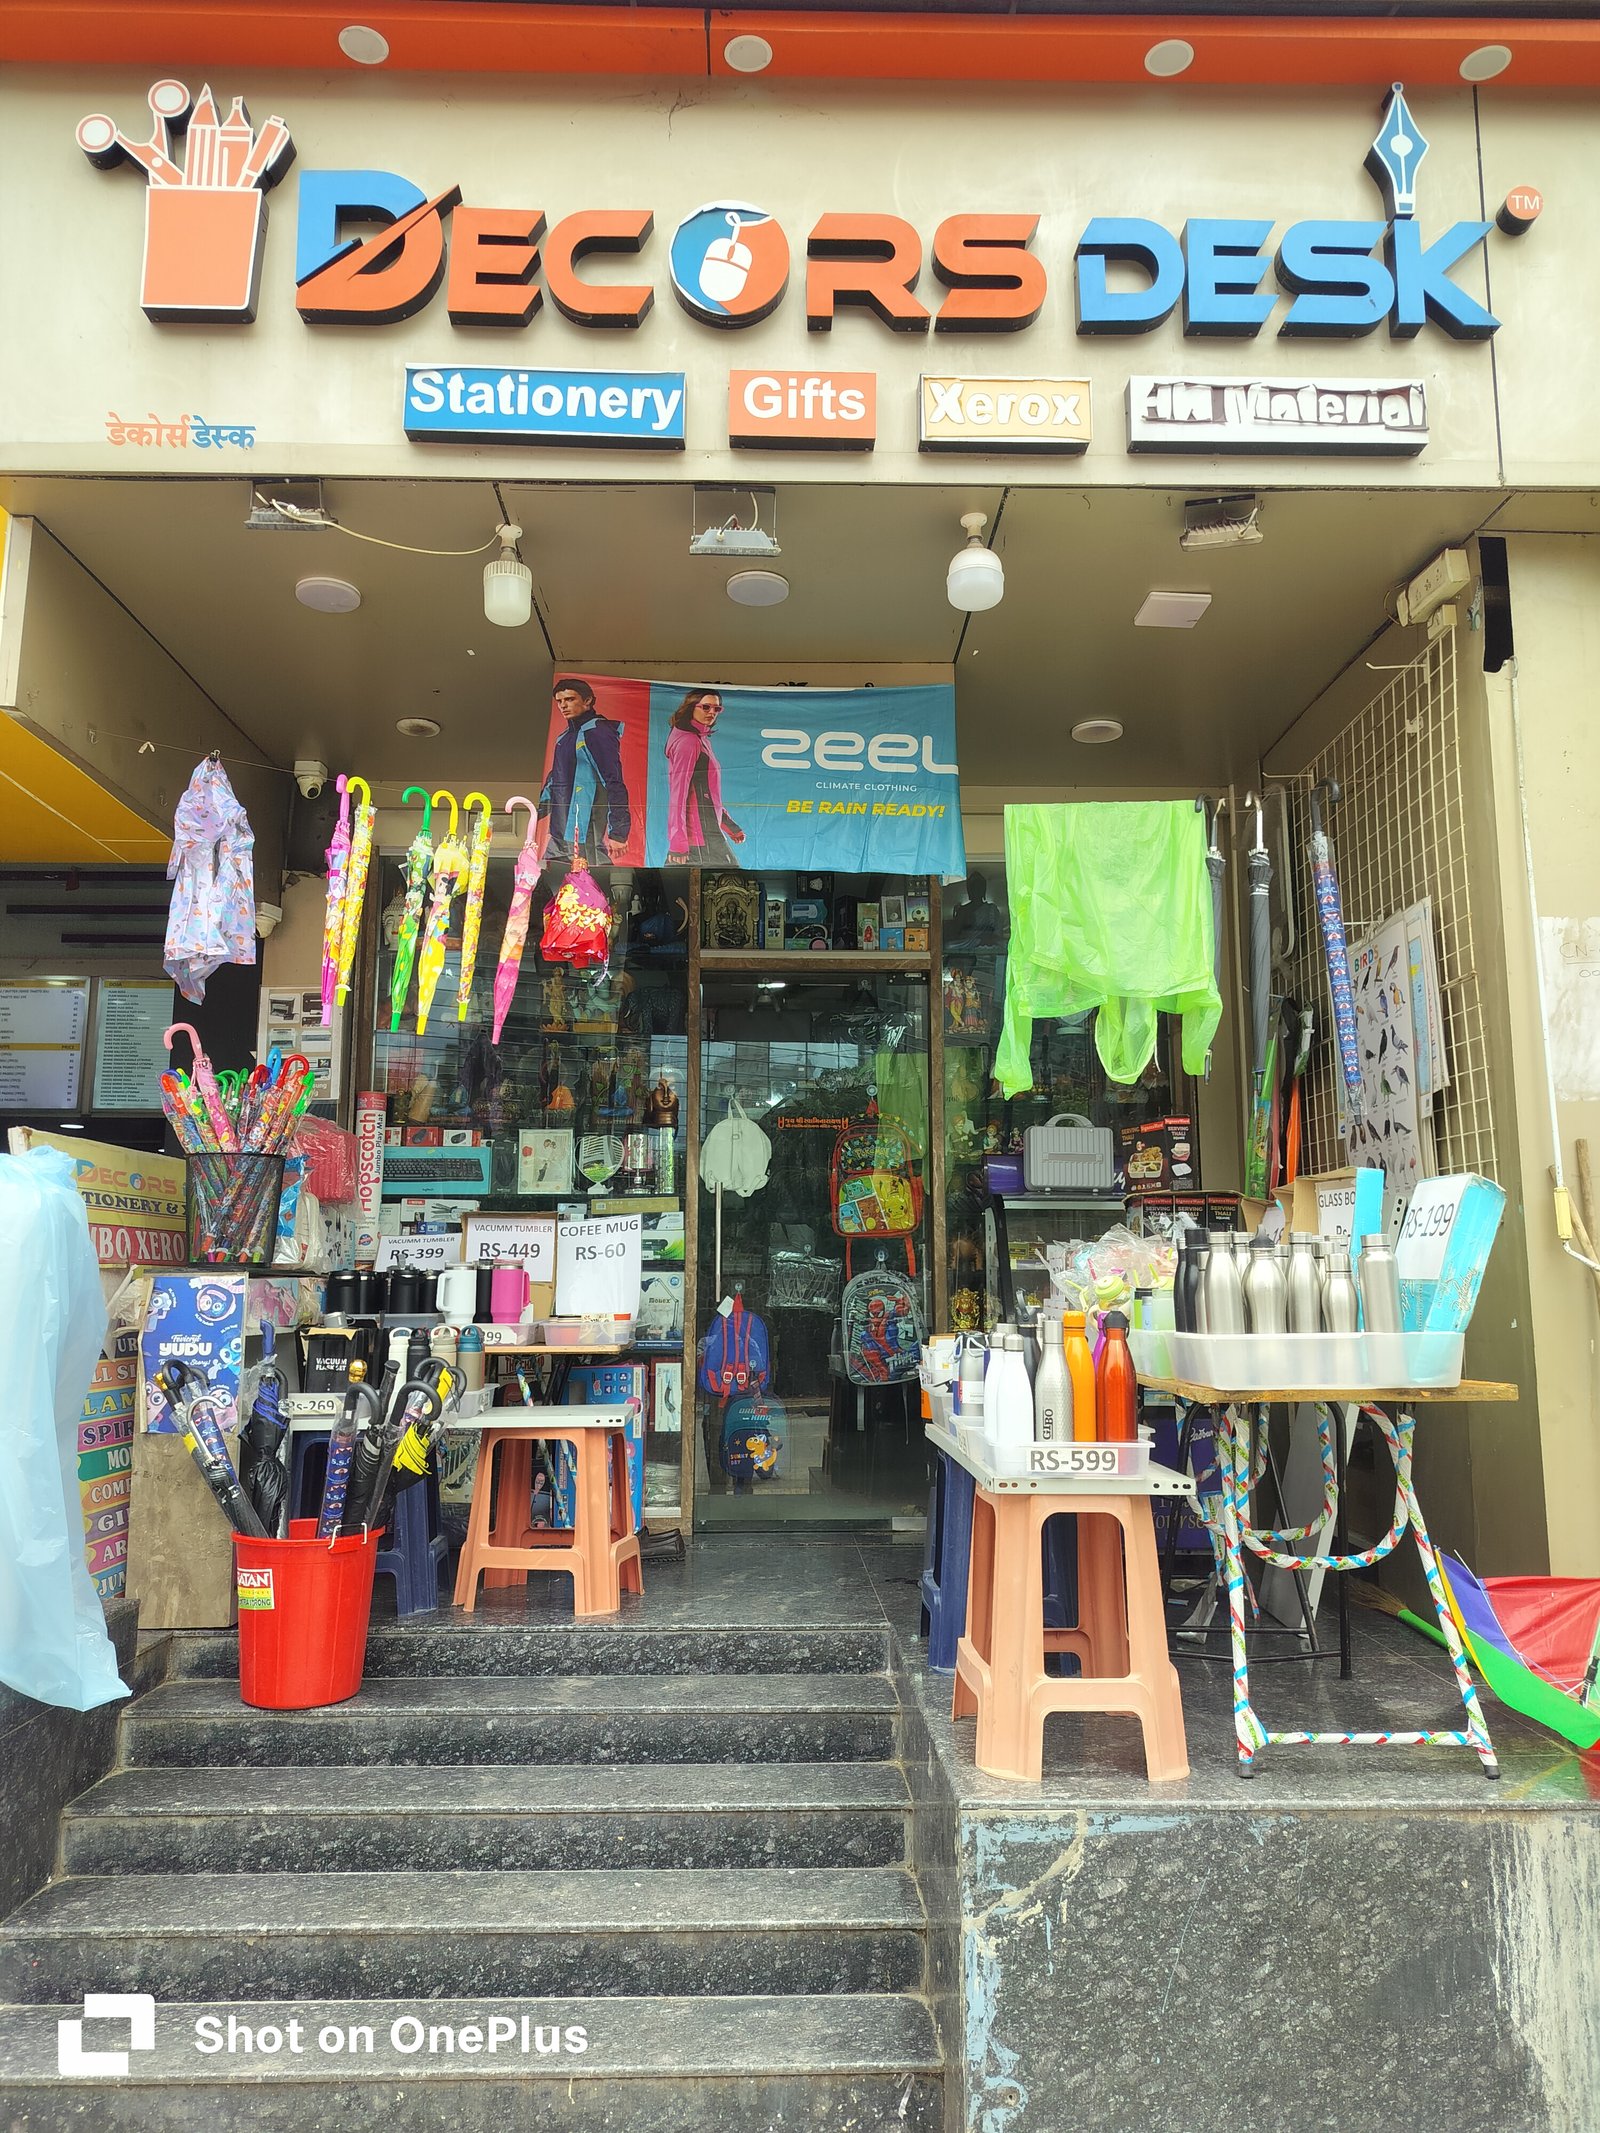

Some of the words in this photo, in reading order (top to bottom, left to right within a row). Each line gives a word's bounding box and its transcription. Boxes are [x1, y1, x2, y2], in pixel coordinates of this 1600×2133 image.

[296, 170, 1048, 326] DECORS
[1076, 216, 1502, 339] DESK
[409, 371, 683, 431] Stationery
[742, 376, 867, 421] Gifts
[928, 380, 1083, 427] Xerox
[815, 781, 861, 791] CLIMATE
[864, 783, 918, 792] CLOTHING
[786, 799, 814, 813] BE
[818, 801, 868, 815] RAIN
[872, 803, 946, 818] READY!
[1354, 944, 1379, 972] BIRDS
[1121, 1127, 1140, 1135] SERVING
[76, 1158, 178, 1195] DECORS
[166, 1202, 178, 1214] &
[1318, 1191, 1343, 1208] GLASS
[474, 1224, 512, 1233] VACUMM
[515, 1224, 553, 1233] TUMBLER
[560, 1224, 601, 1237] COFEE
[605, 1219, 639, 1233] MUG
[1401, 1203, 1455, 1240] RS-199
[390, 1247, 444, 1261] RS-399
[479, 1242, 541, 1260] RS-449
[575, 1243, 626, 1261] RS-60
[159, 1343, 212, 1356] YUDU
[1042, 1408, 1054, 1440] GIBO
[107, 1447, 132, 1471] MO
[1030, 1450, 1116, 1471] RS-599
[97, 1508, 129, 1532] GI
